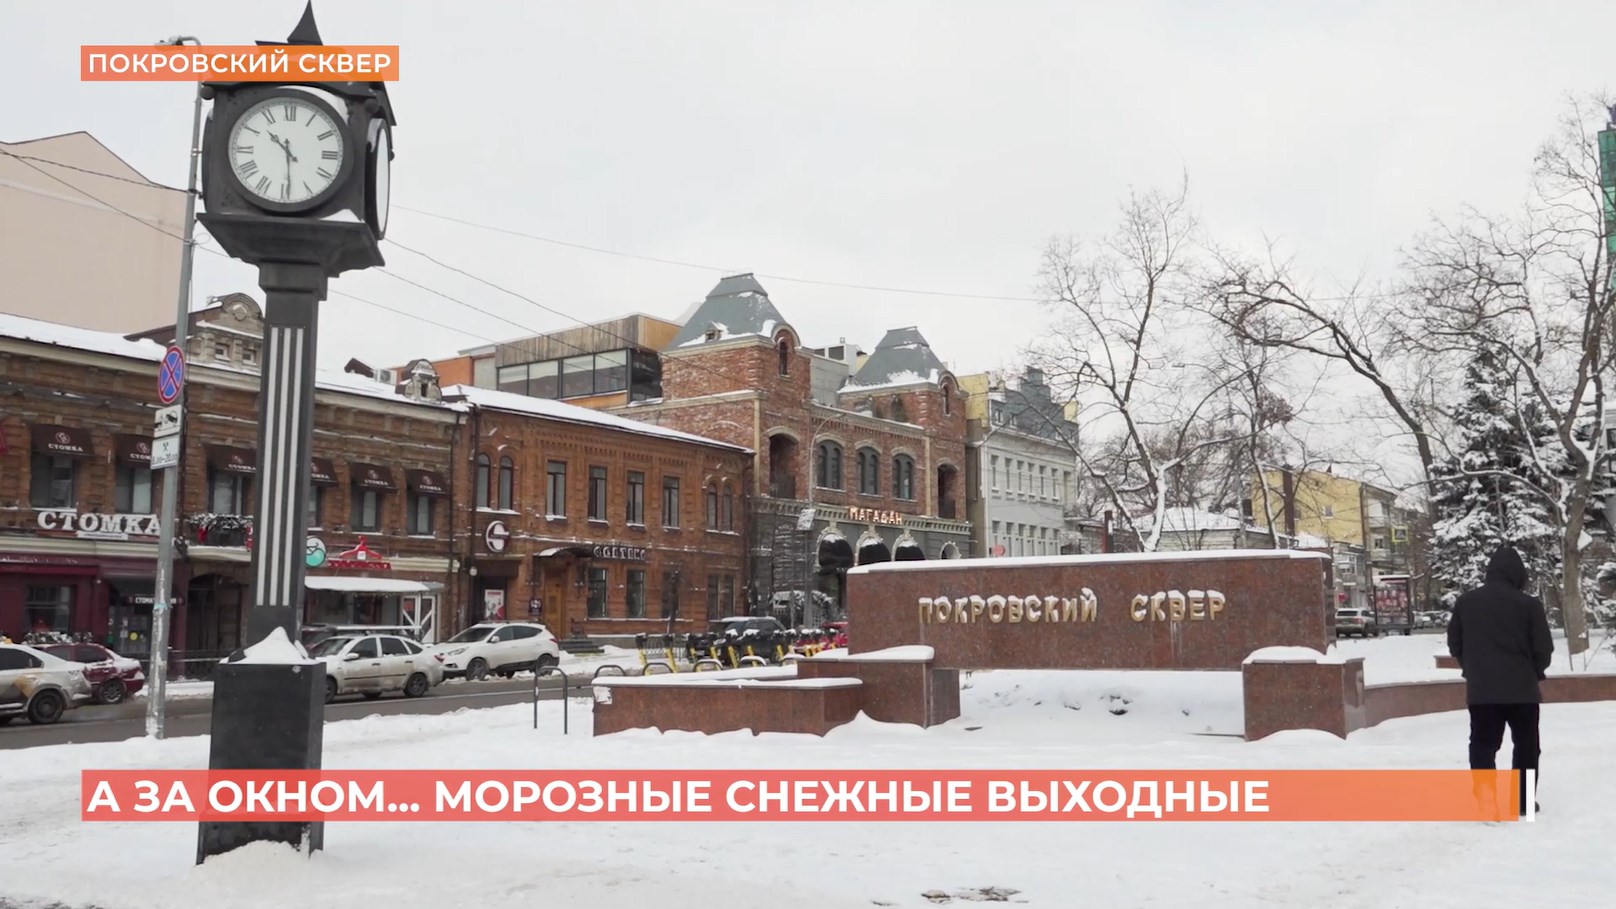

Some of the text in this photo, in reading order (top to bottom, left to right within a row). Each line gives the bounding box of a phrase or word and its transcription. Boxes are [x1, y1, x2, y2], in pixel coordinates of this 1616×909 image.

[321, 150, 338, 160] III
[48, 443, 83, 452] СТОМКА
[37, 512, 161, 536] СТОМКА
[918, 588, 1226, 623] ПОКРОВСКИЙ СКВЕР
